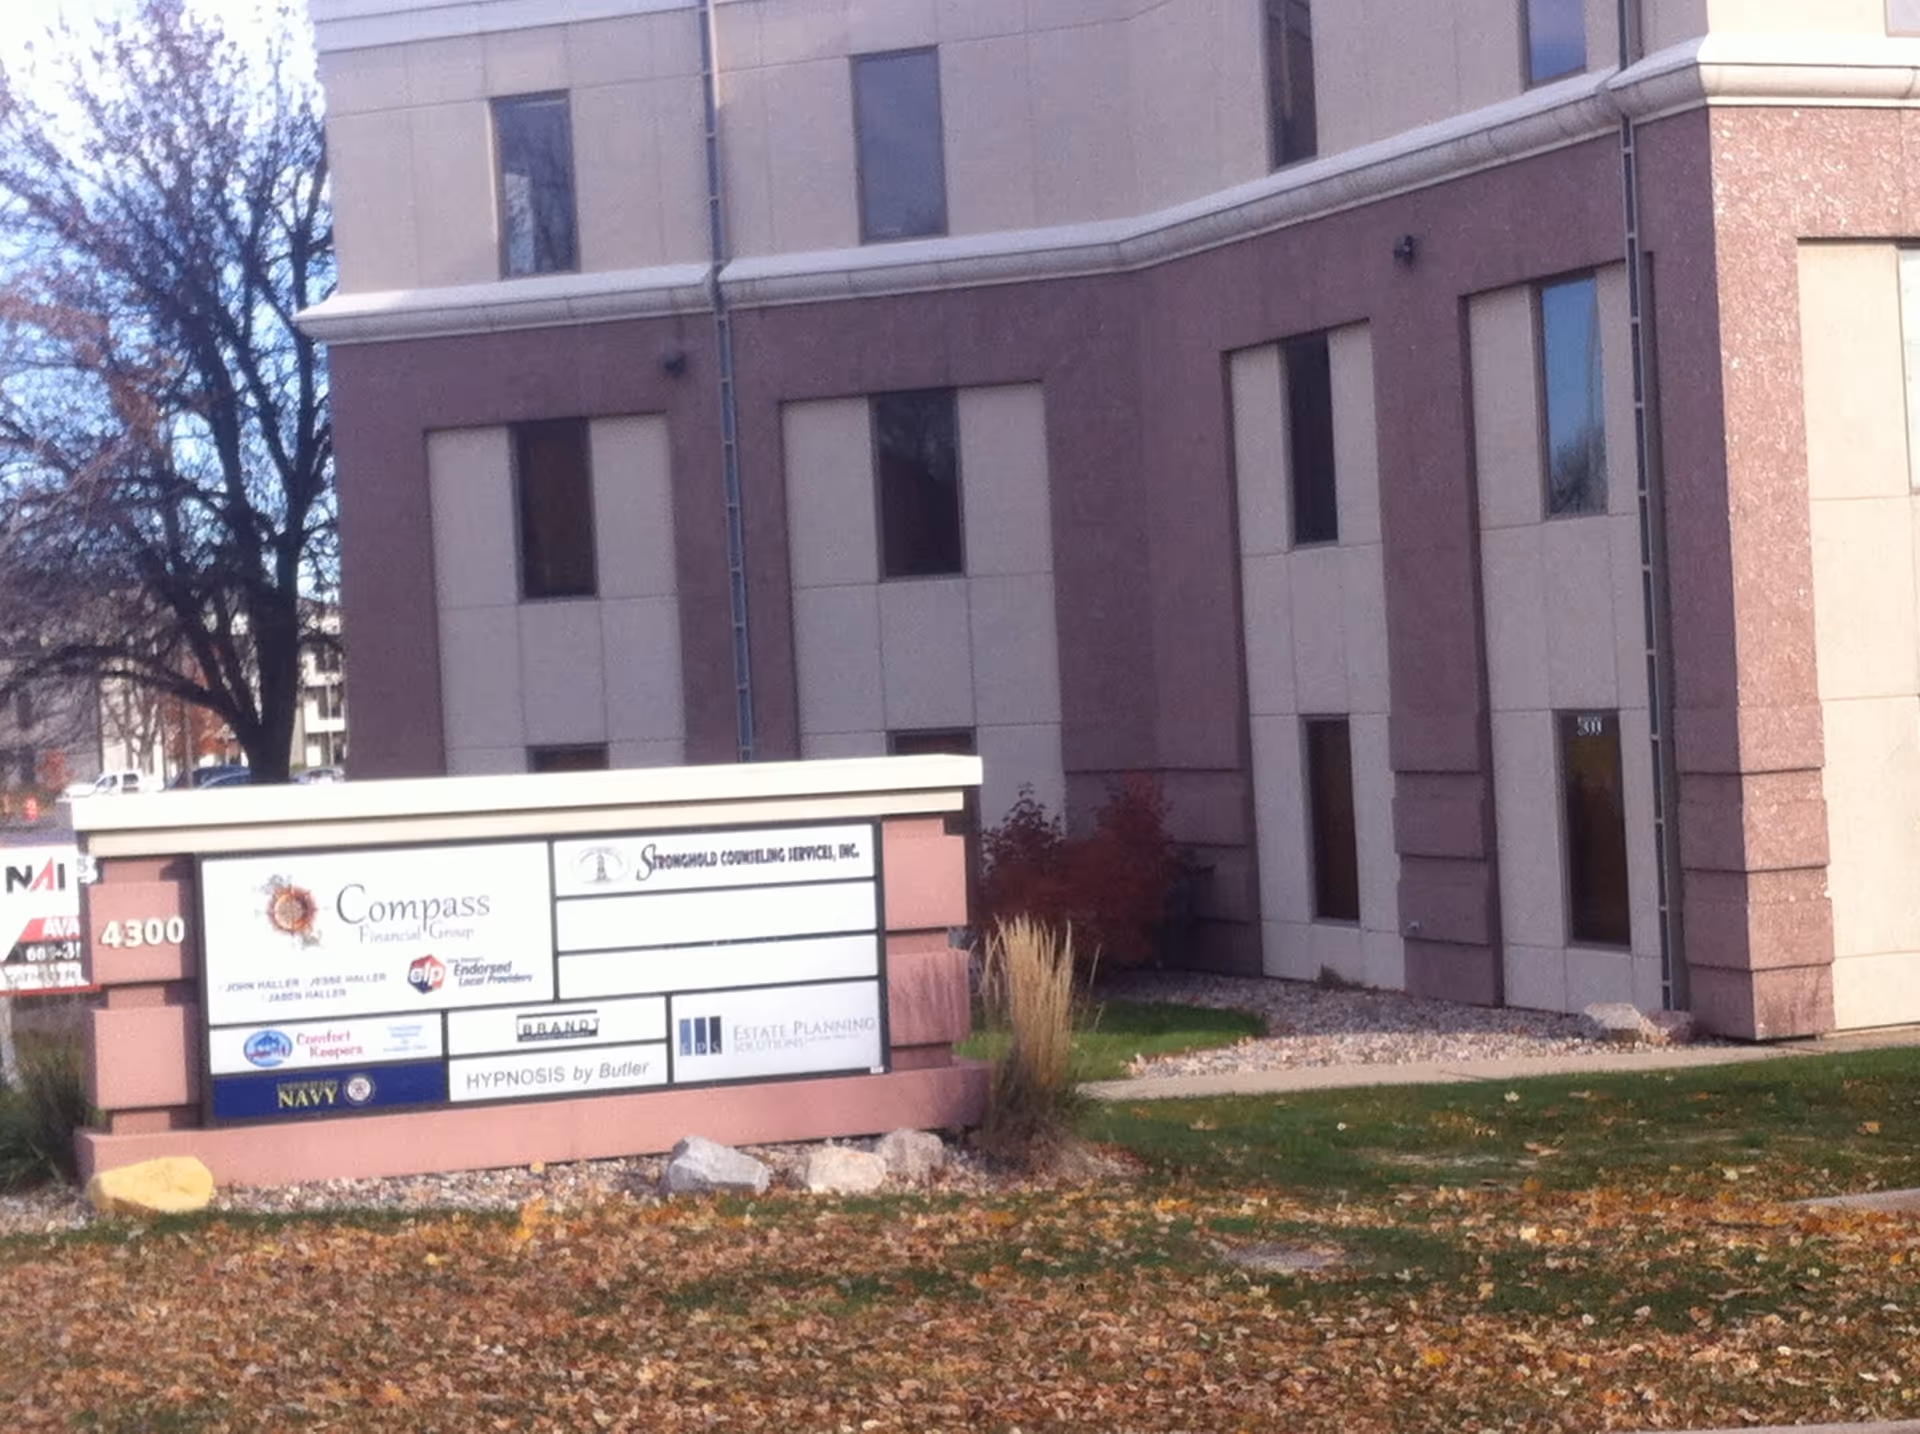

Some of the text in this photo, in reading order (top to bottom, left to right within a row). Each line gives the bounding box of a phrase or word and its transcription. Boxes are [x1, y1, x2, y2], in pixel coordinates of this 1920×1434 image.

[636, 843, 717, 881] STRONGHOLD
[720, 848, 786, 866] COUNSELING
[6, 857, 66, 893] NAI
[336, 883, 490, 932] Compass
[101, 916, 185, 948] 4300
[359, 919, 474, 944] Financial Group
[454, 961, 513, 977] Endorsed
[257, 978, 300, 990] HALLER
[345, 972, 387, 983] HALLER
[304, 988, 347, 1000] HALLER
[296, 1031, 352, 1047] Comfort
[522, 1018, 601, 1037] BRANDT
[734, 1024, 786, 1041] ESTATE
[793, 1017, 876, 1036] PLANNING
[308, 1044, 366, 1060] Keepers
[466, 1060, 649, 1090] HYPNOSIS by Butler
[278, 1087, 338, 1109] NAVY
